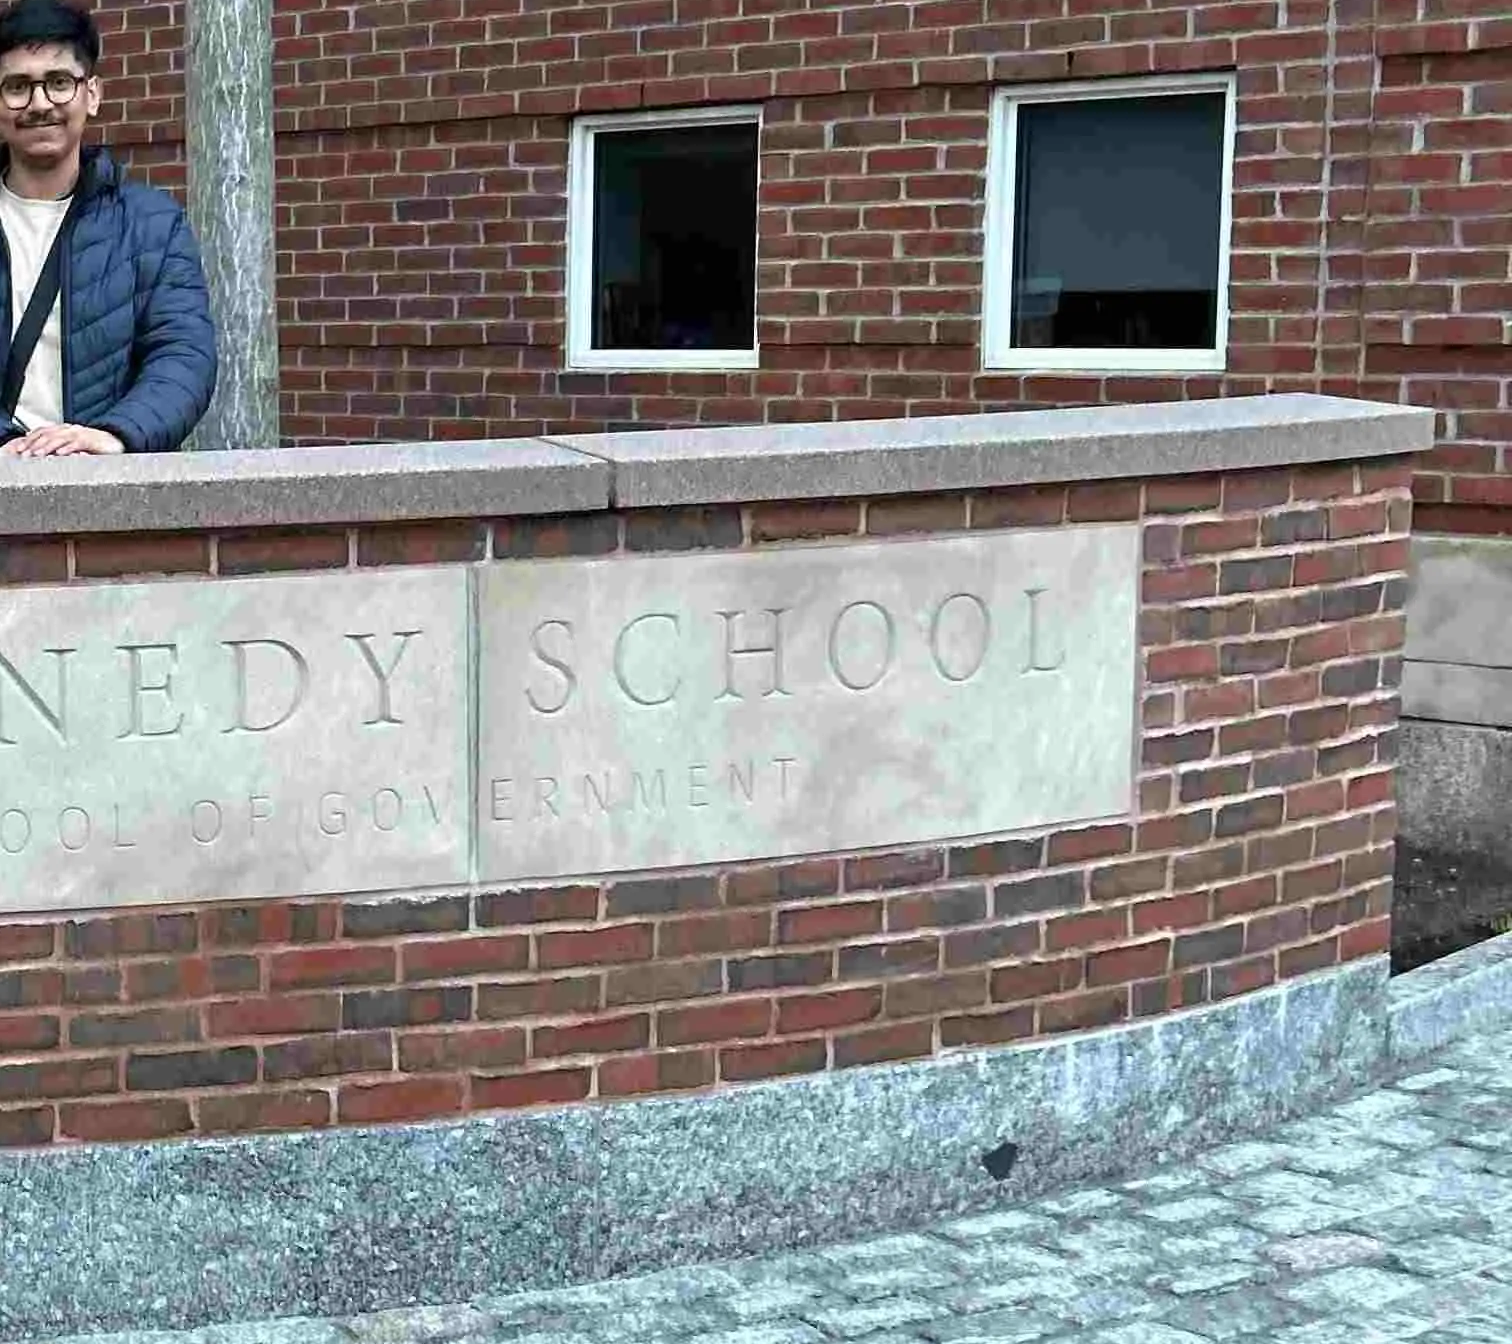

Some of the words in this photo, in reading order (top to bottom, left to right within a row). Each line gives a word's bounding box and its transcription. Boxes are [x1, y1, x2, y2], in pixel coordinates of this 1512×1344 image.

[524, 587, 1068, 716] SCHOOL
[189, 792, 278, 847] OF
[318, 756, 800, 837] GOVERNMENT
